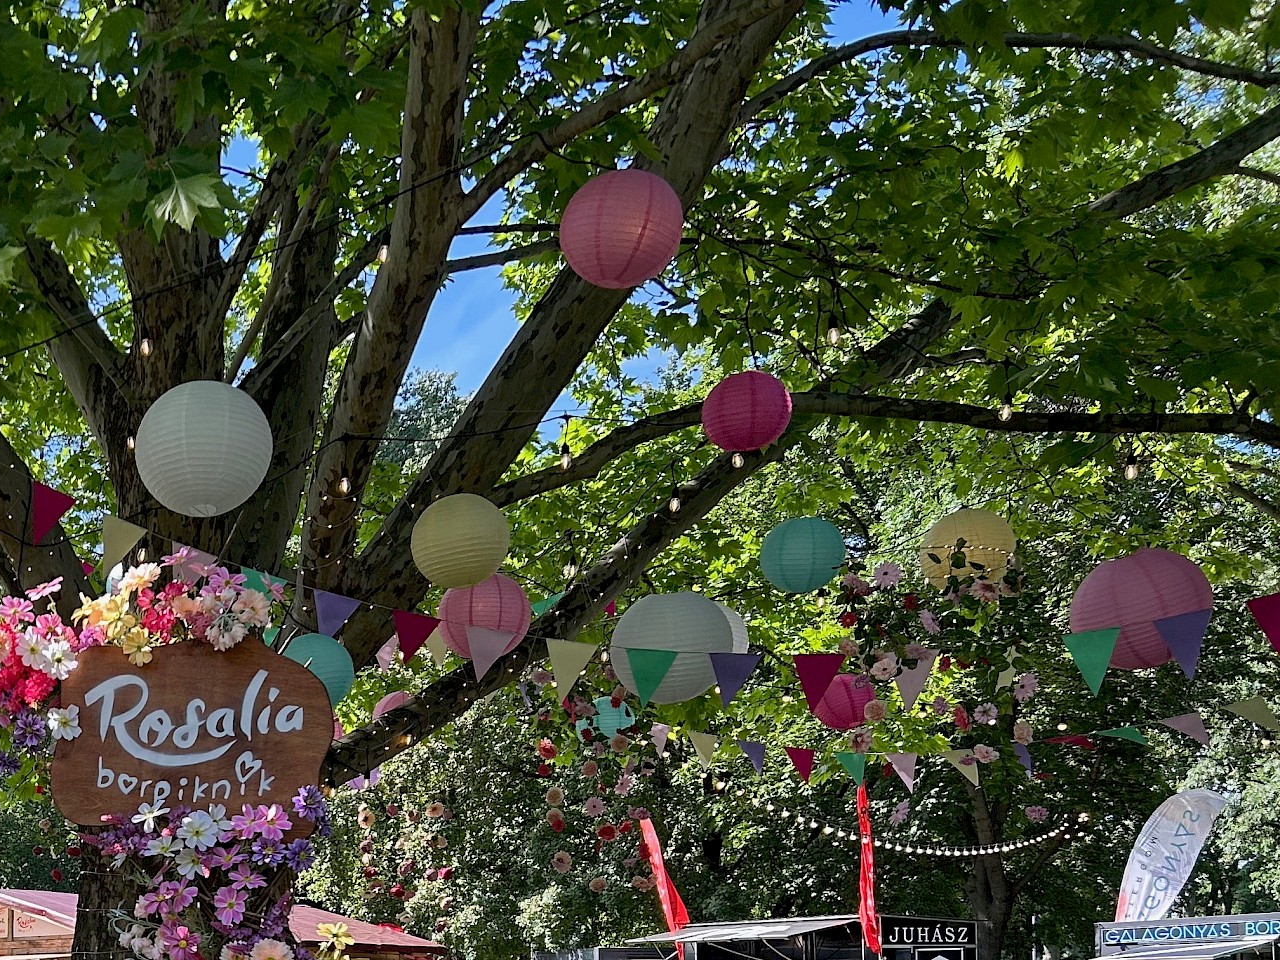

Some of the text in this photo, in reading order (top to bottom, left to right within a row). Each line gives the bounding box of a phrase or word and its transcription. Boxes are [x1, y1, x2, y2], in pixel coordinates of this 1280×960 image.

[85, 669, 304, 767] Rosalia
[97, 751, 276, 807] borpiknik
[889, 923, 969, 943] JUHÁSZ
